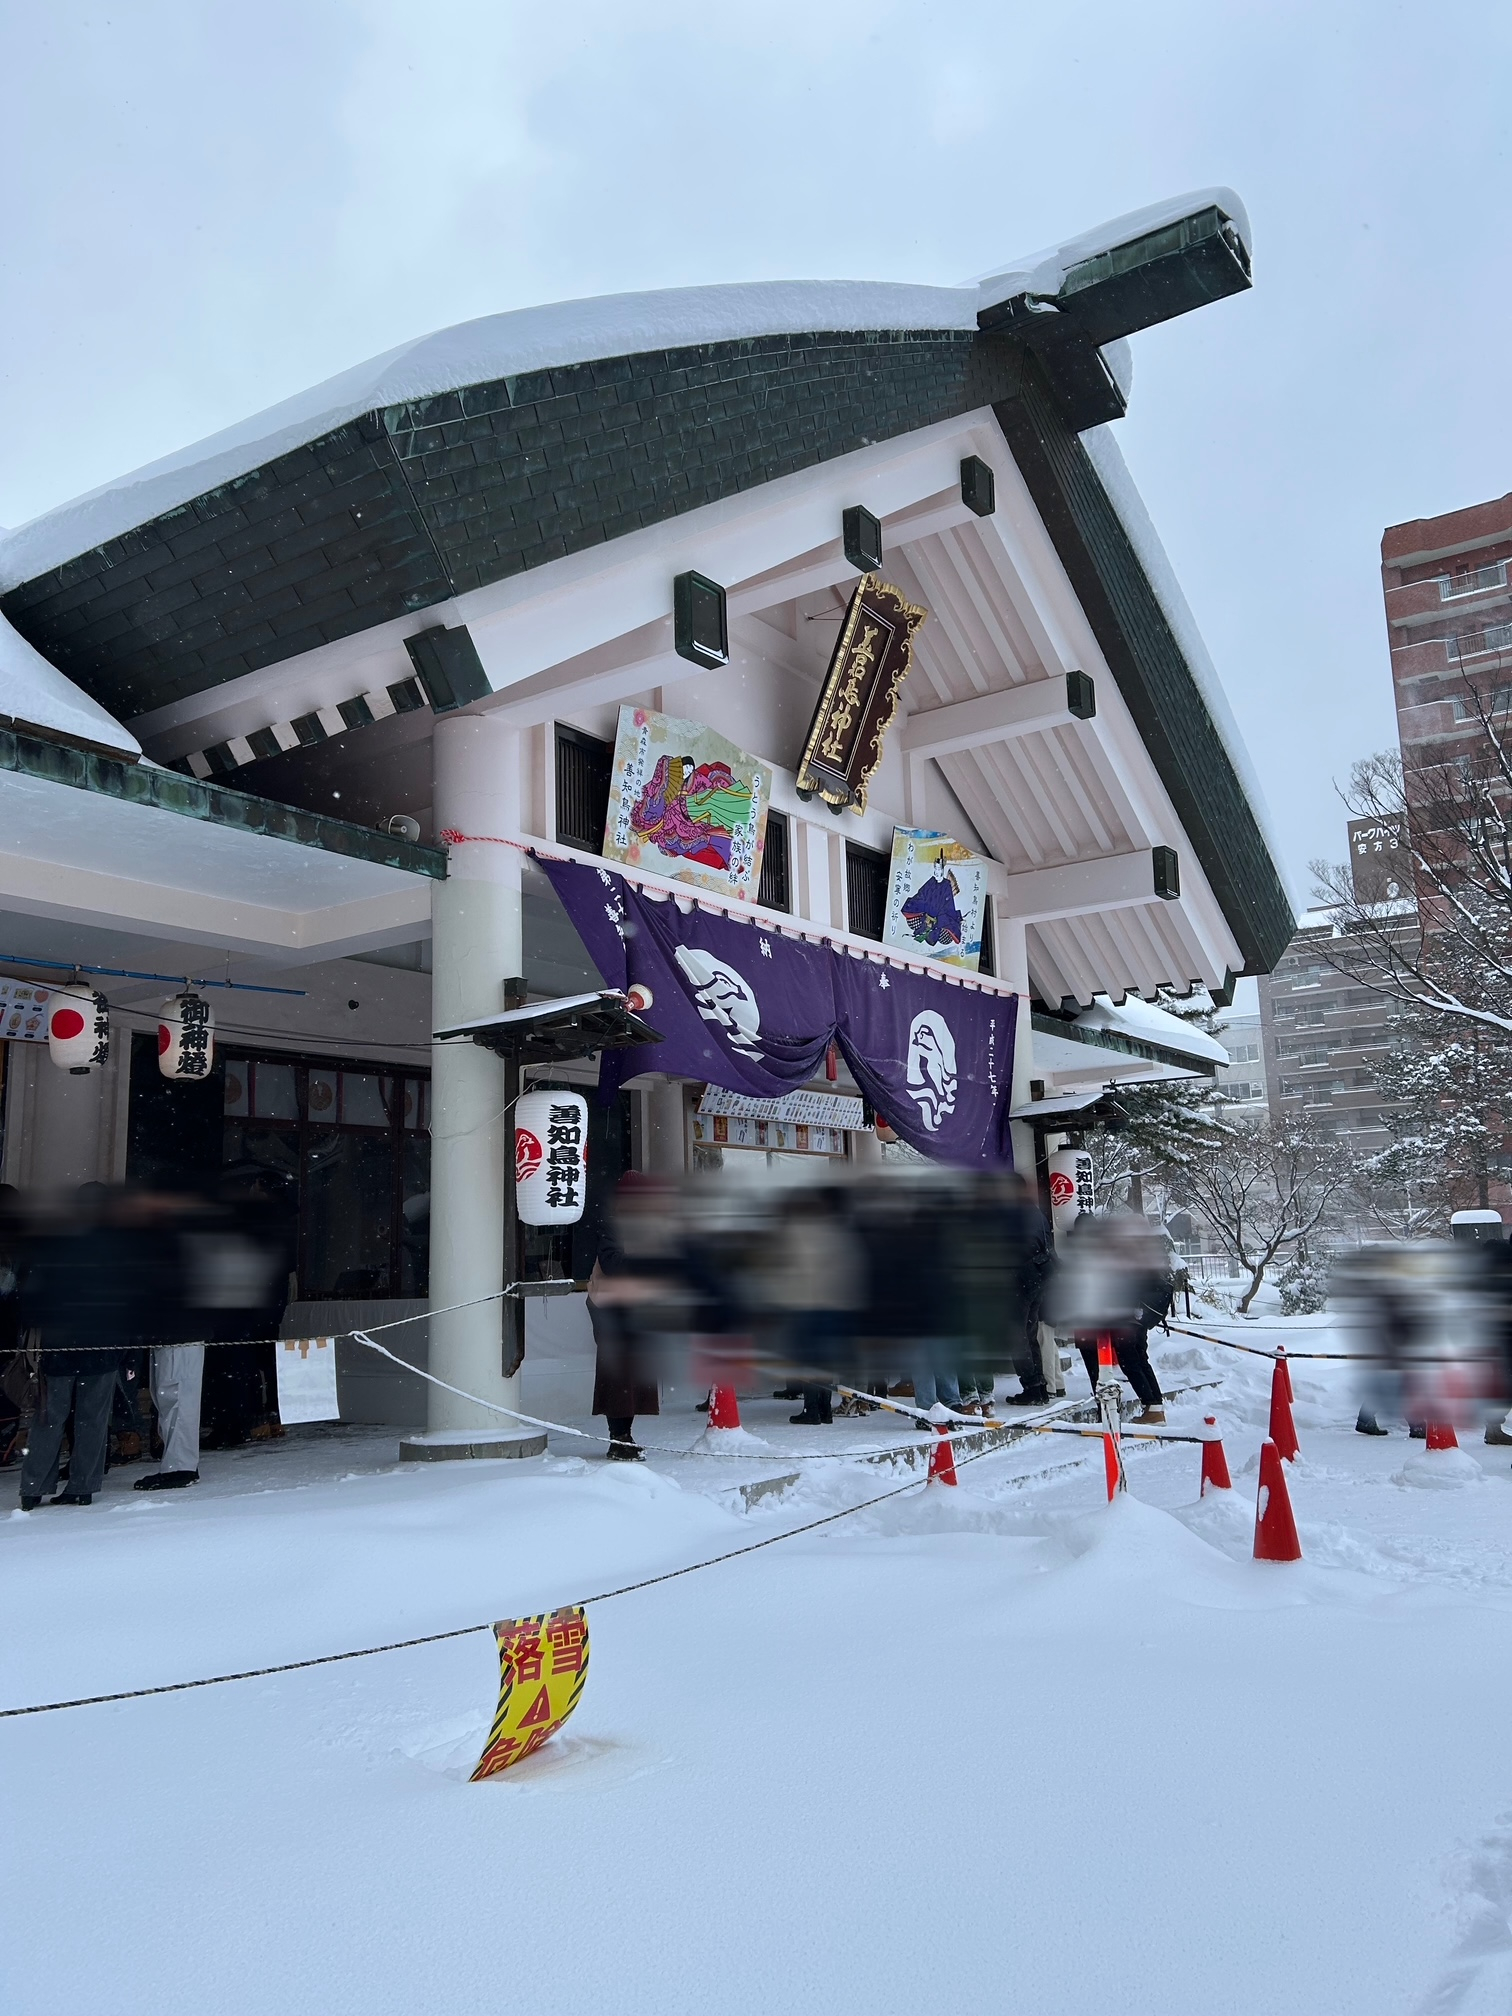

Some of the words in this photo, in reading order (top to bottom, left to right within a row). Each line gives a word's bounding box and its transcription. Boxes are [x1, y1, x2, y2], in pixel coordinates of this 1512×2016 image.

[633, 726, 649, 798] 青森市発祥の地
[615, 762, 635, 846] 善知鳥神社
[741, 776, 760, 883] うとう鳥が結ぶ
[728, 824, 744, 884] 家族の絆
[902, 842, 915, 893] わが故郷
[759, 936, 773, 959] 納
[878, 971, 891, 990] 奉
[987, 1019, 999, 1098] 平成二十七年
[545, 1104, 582, 1208] 善知鳥神社
[497, 1613, 587, 1686] 落雪
